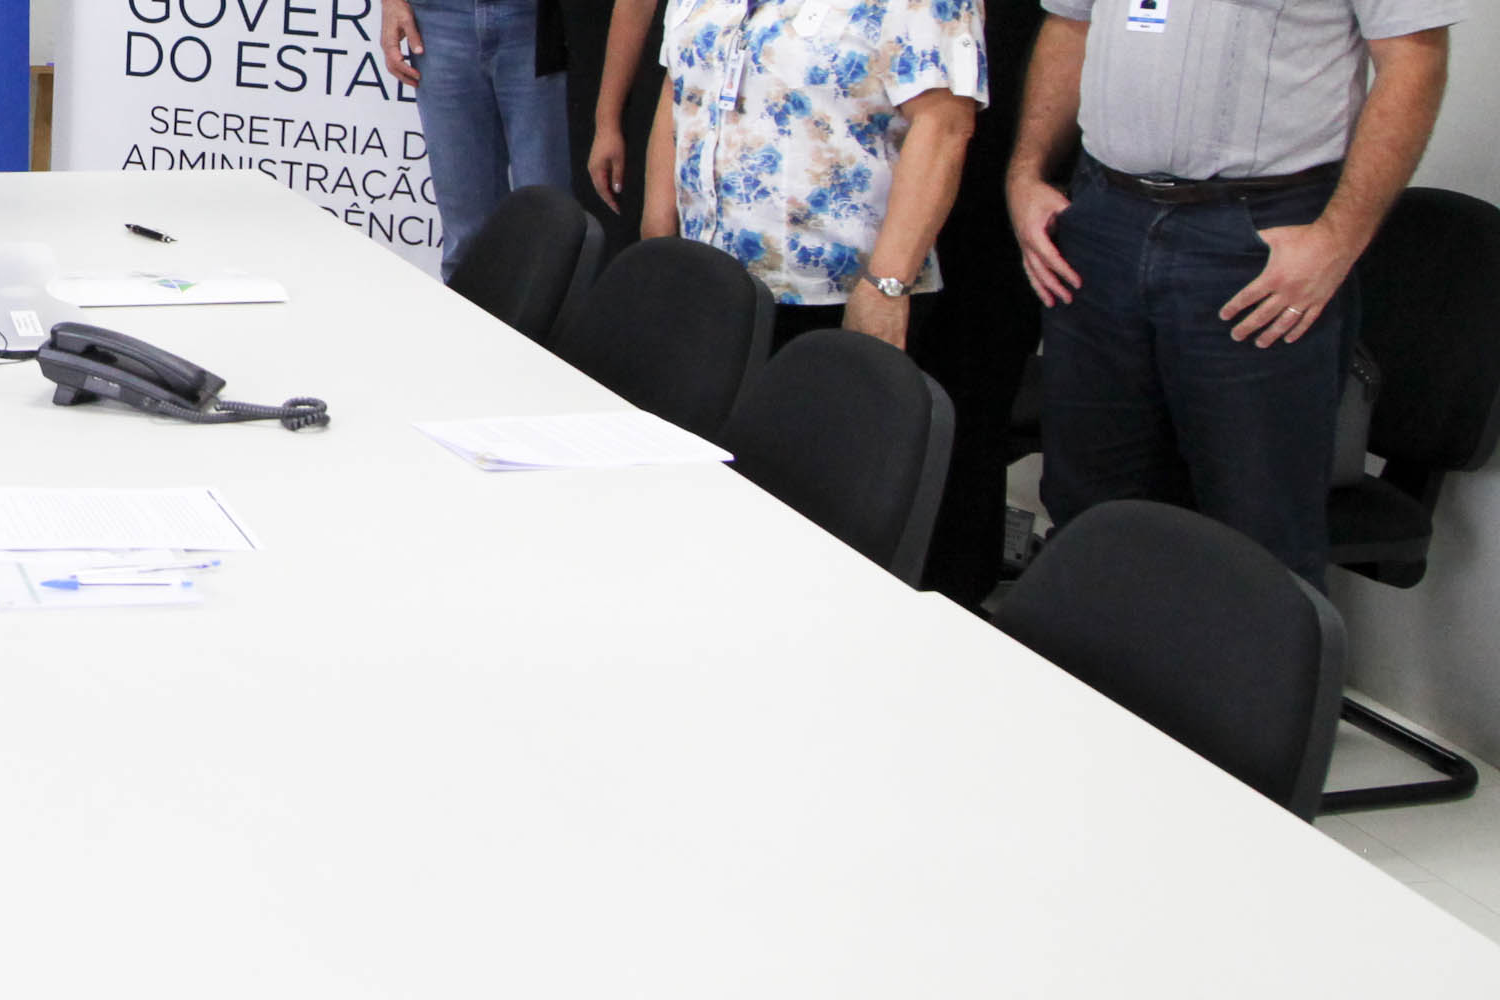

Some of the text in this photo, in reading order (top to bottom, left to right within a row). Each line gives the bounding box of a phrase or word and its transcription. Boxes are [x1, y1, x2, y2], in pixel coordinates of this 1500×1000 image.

[125, 31, 212, 83] DO
[149, 105, 388, 159] SECRETARIA
[319, 202, 444, 248] ÊNCI
